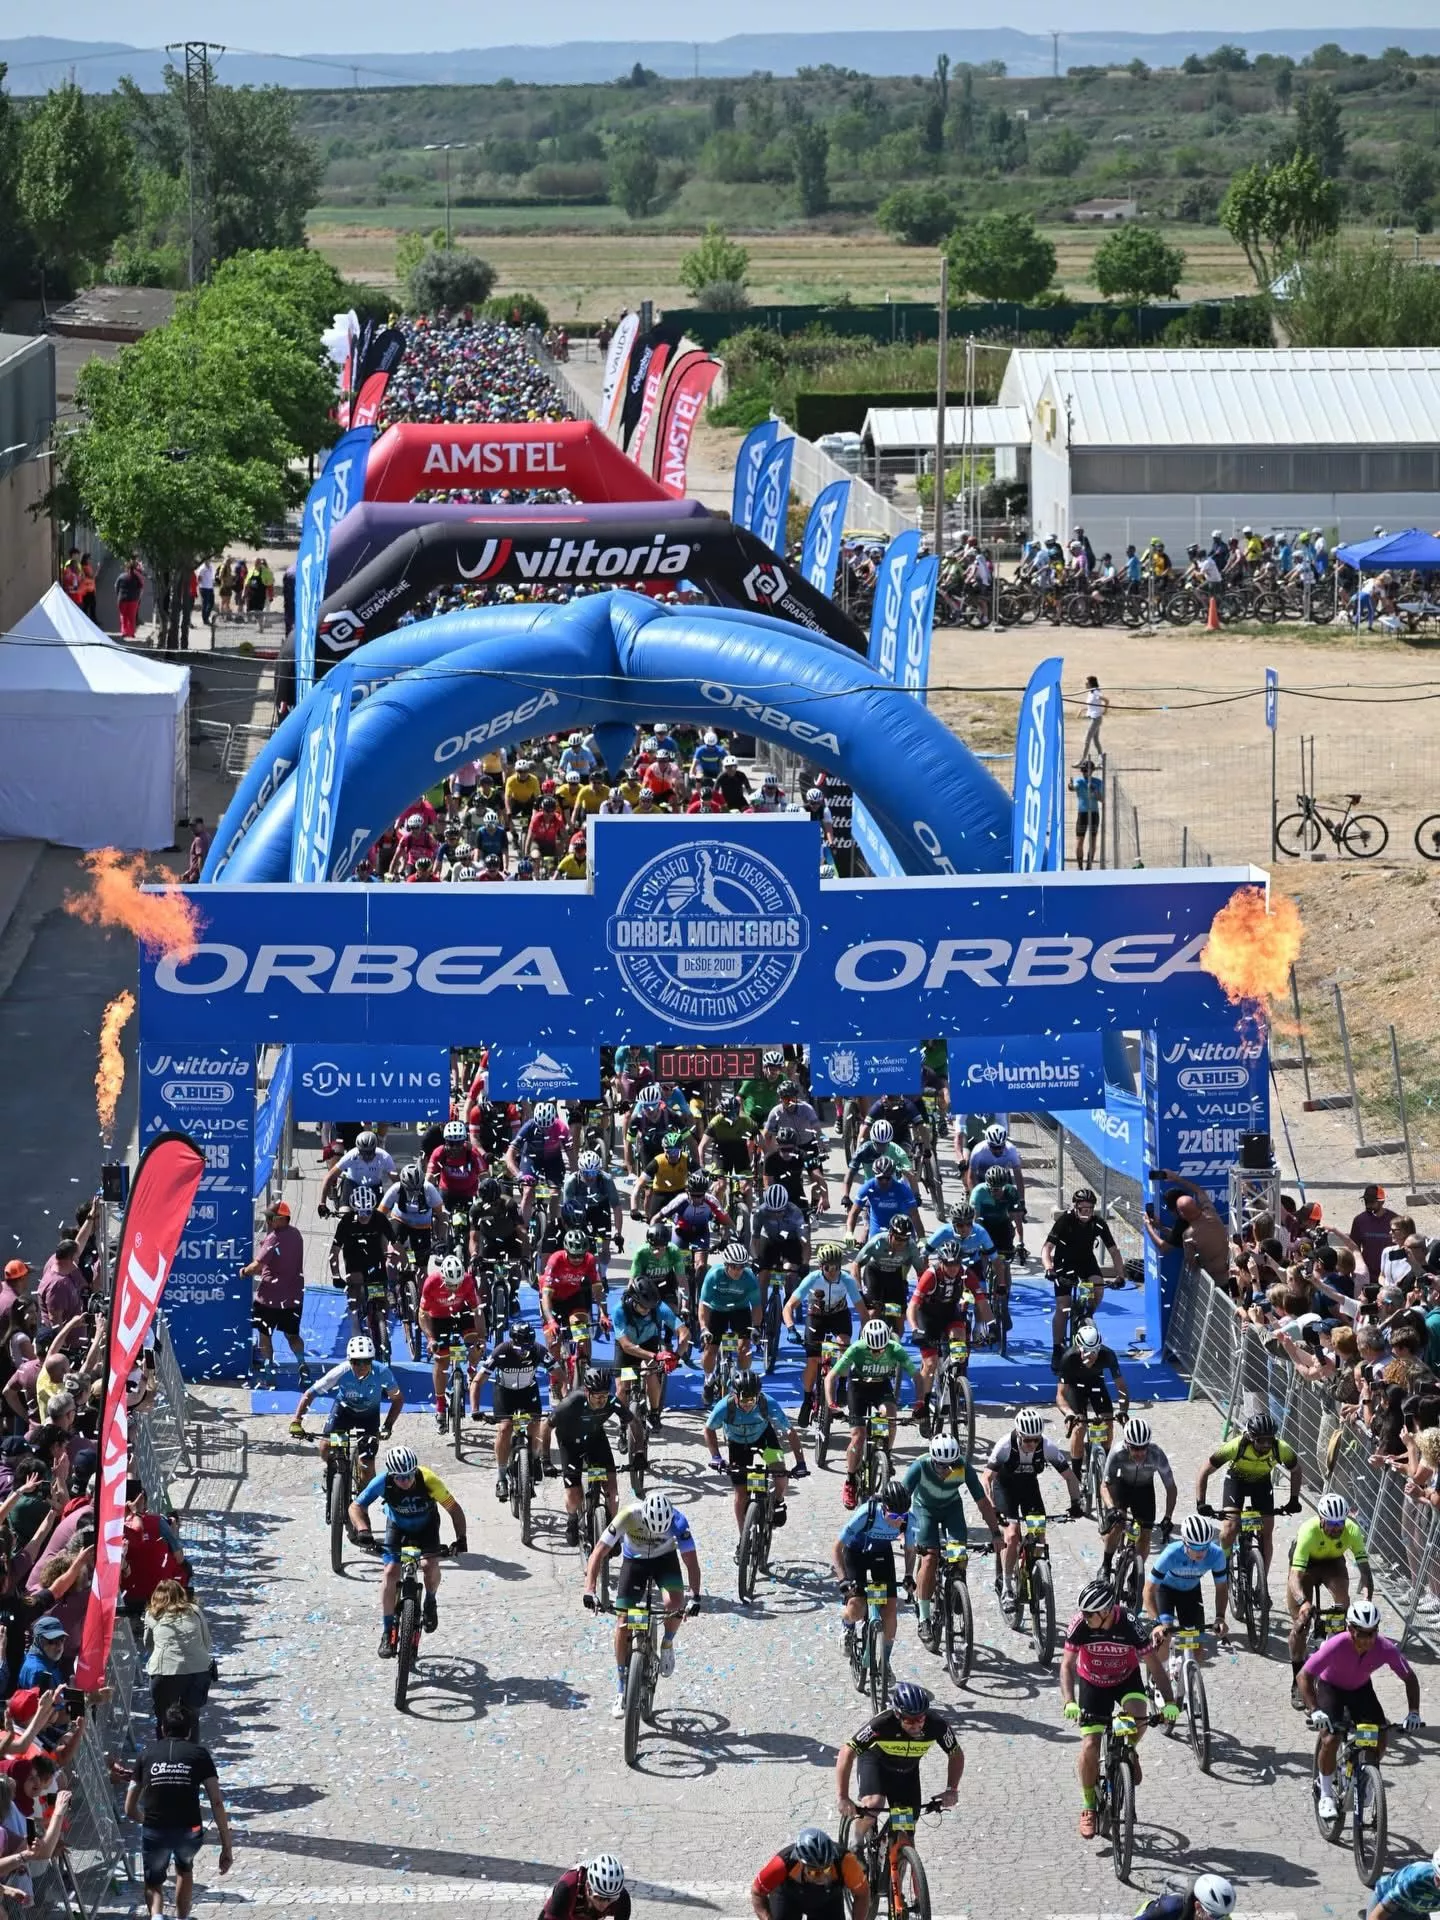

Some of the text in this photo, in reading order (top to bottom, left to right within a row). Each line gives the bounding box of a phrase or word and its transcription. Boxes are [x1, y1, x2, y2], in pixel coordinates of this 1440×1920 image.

[610, 325, 631, 376] VAUDE
[664, 390, 704, 490] AMSTEL
[422, 442, 567, 474] AMSTEL
[761, 457, 784, 550] BEA
[514, 534, 692, 579] vittoria
[810, 500, 838, 594] BEA
[360, 579, 411, 621] GRAPHENE
[433, 687, 560, 763] ORBEA
[700, 682, 841, 757] ORBEA
[1020, 686, 1051, 873] RBEA
[633, 856, 690, 913] EL DESAFIO
[717, 854, 784, 911] DEL DESIERTO
[617, 921, 800, 947] ORBEA MONEGROS
[155, 943, 573, 996] ORBEA
[684, 957, 735, 972] DESDE 2001
[632, 956, 787, 1016] BIKE MARATHON DESERT
[172, 1056, 250, 1075] vittoria
[1187, 1041, 1264, 1061] vittoria
[302, 1072, 441, 1087] SUNLIVING
[532, 1081, 571, 1089] Monegros
[968, 1060, 1080, 1084] Columbus
[1008, 1080, 1079, 1090] DISCOVER NATURE
[1187, 1071, 1239, 1085] ABUS
[171, 1086, 225, 1099] ABUS
[1196, 1102, 1265, 1116] VAUDE
[179, 1118, 249, 1131] VAUDE
[1179, 1160, 1240, 1177] DH
[175, 1238, 242, 1260] MSTEL
